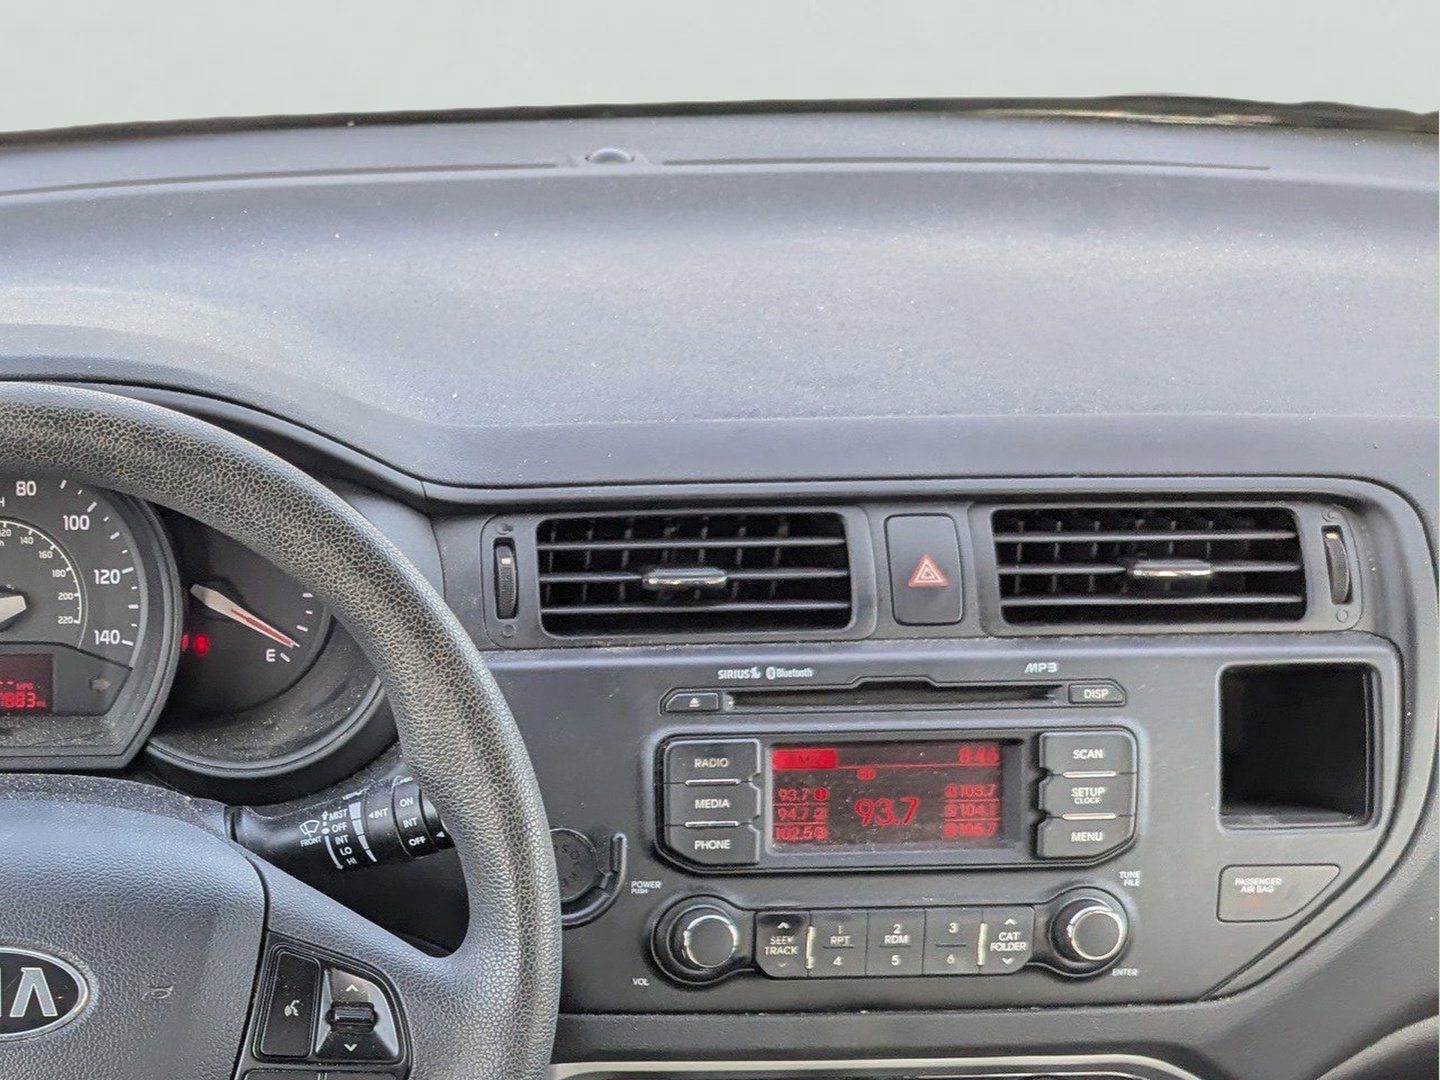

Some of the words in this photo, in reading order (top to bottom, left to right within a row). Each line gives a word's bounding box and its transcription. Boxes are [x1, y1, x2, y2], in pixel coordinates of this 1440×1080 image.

[16, 481, 37, 497] 80
[63, 515, 89, 530] 100
[20, 537, 34, 545] 140
[39, 551, 53, 559] 160
[52, 569, 66, 578] 180
[94, 569, 120, 585] 120
[58, 592, 73, 600] 200
[58, 616, 73, 624] 220
[94, 630, 120, 645] 140
[266, 650, 276, 662] E
[1024, 662, 1059, 673] MP3
[717, 669, 750, 679] SIRIUS
[776, 668, 813, 678] Bluetooth
[1083, 689, 1109, 699] DISP
[1072, 749, 1104, 759] SCAN
[694, 758, 730, 768] RADIO
[1071, 787, 1106, 797] SETUP
[400, 797, 414, 807] ON
[694, 799, 730, 809] MEDIA
[329, 808, 348, 821] MIST
[374, 808, 388, 819] INT
[854, 797, 921, 826] 93.7
[331, 822, 347, 833] OFF
[402, 817, 418, 828] INT
[300, 835, 322, 847] FRONT
[335, 834, 348, 845] INT
[408, 836, 426, 846] OFF
[1071, 832, 1104, 842] MENU
[694, 839, 731, 850] PHONE
[339, 846, 353, 856] LO
[346, 857, 358, 865] HI
[1119, 871, 1141, 879] TUNE
[631, 881, 661, 889] POWER
[1234, 877, 1282, 886] PASSENGER
[893, 924, 902, 934] 2
[949, 923, 958, 934] 3
[770, 935, 794, 945] SEEK
[830, 936, 851, 945] RPT
[884, 934, 909, 944] RDM
[999, 931, 1021, 942] CAT
[764, 945, 798, 955] TRACK
[990, 941, 1026, 952] FOLDER
[832, 956, 844, 966] 4
[891, 955, 901, 965] 5
[946, 954, 955, 964] 6
[1112, 968, 1138, 977] ENTER
[632, 978, 649, 986] VOL
